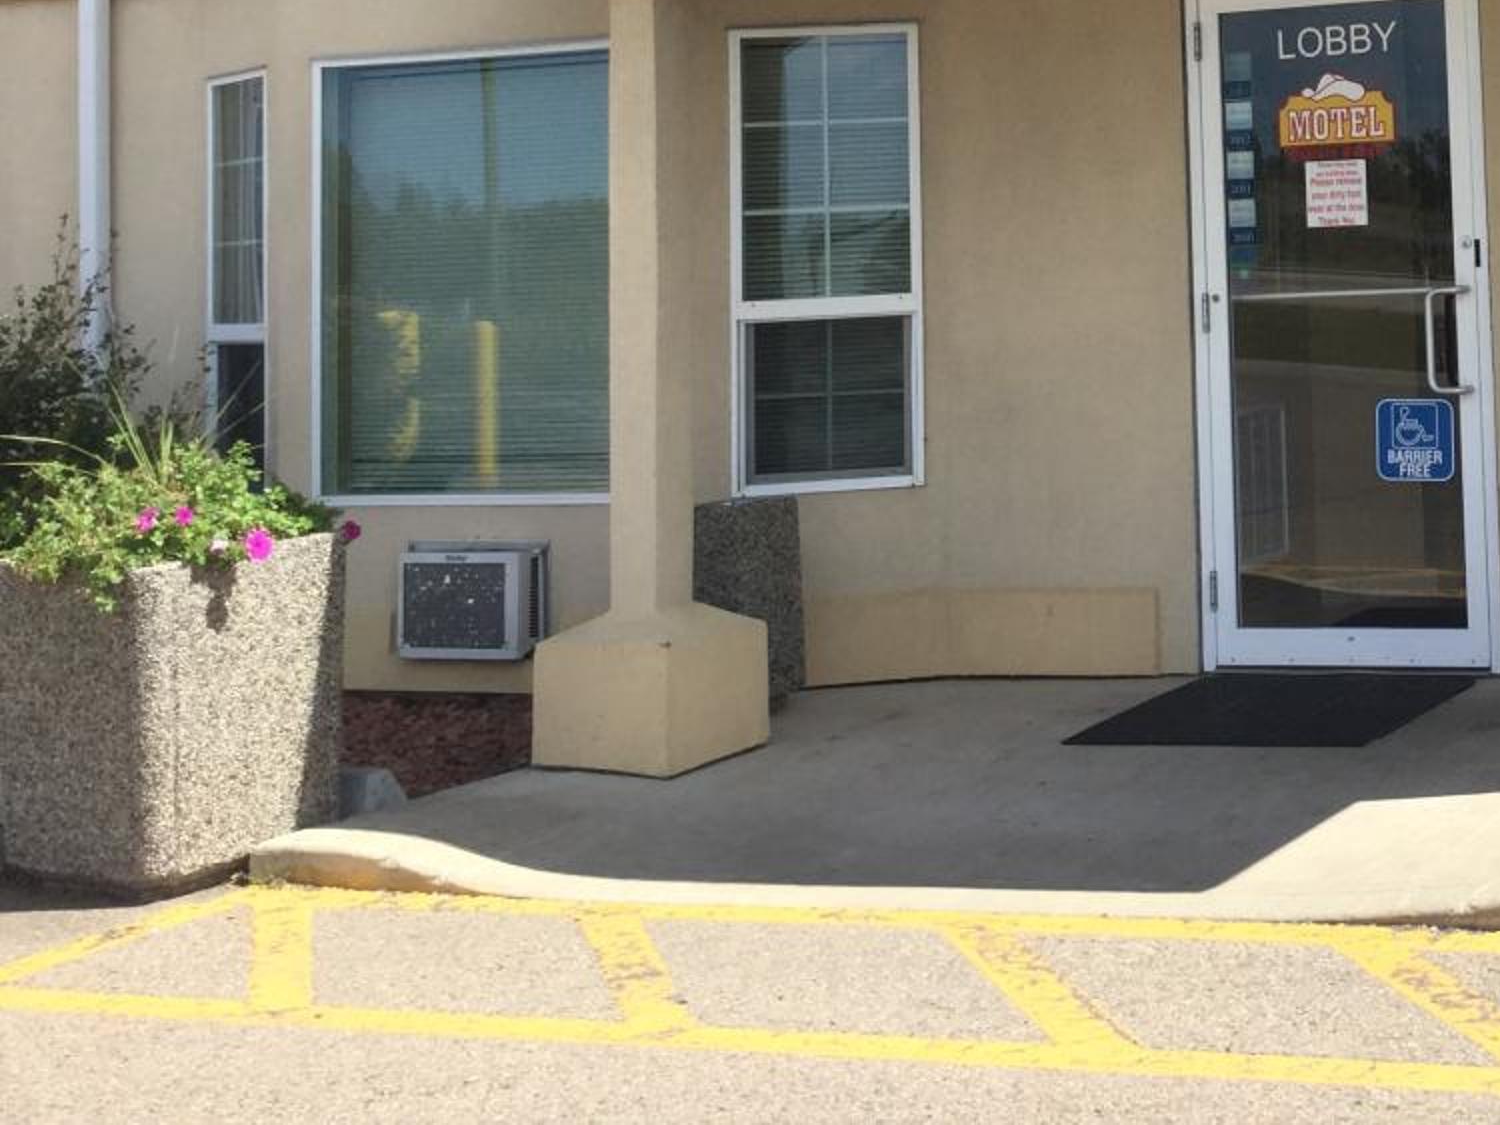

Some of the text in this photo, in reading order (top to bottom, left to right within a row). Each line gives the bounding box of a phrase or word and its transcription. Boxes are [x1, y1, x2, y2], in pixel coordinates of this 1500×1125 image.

[1276, 21, 1396, 60] LOBBY
[1288, 105, 1385, 142] MOTEL
[1387, 449, 1443, 465] BARRIER
[1400, 463, 1432, 478] FREE
